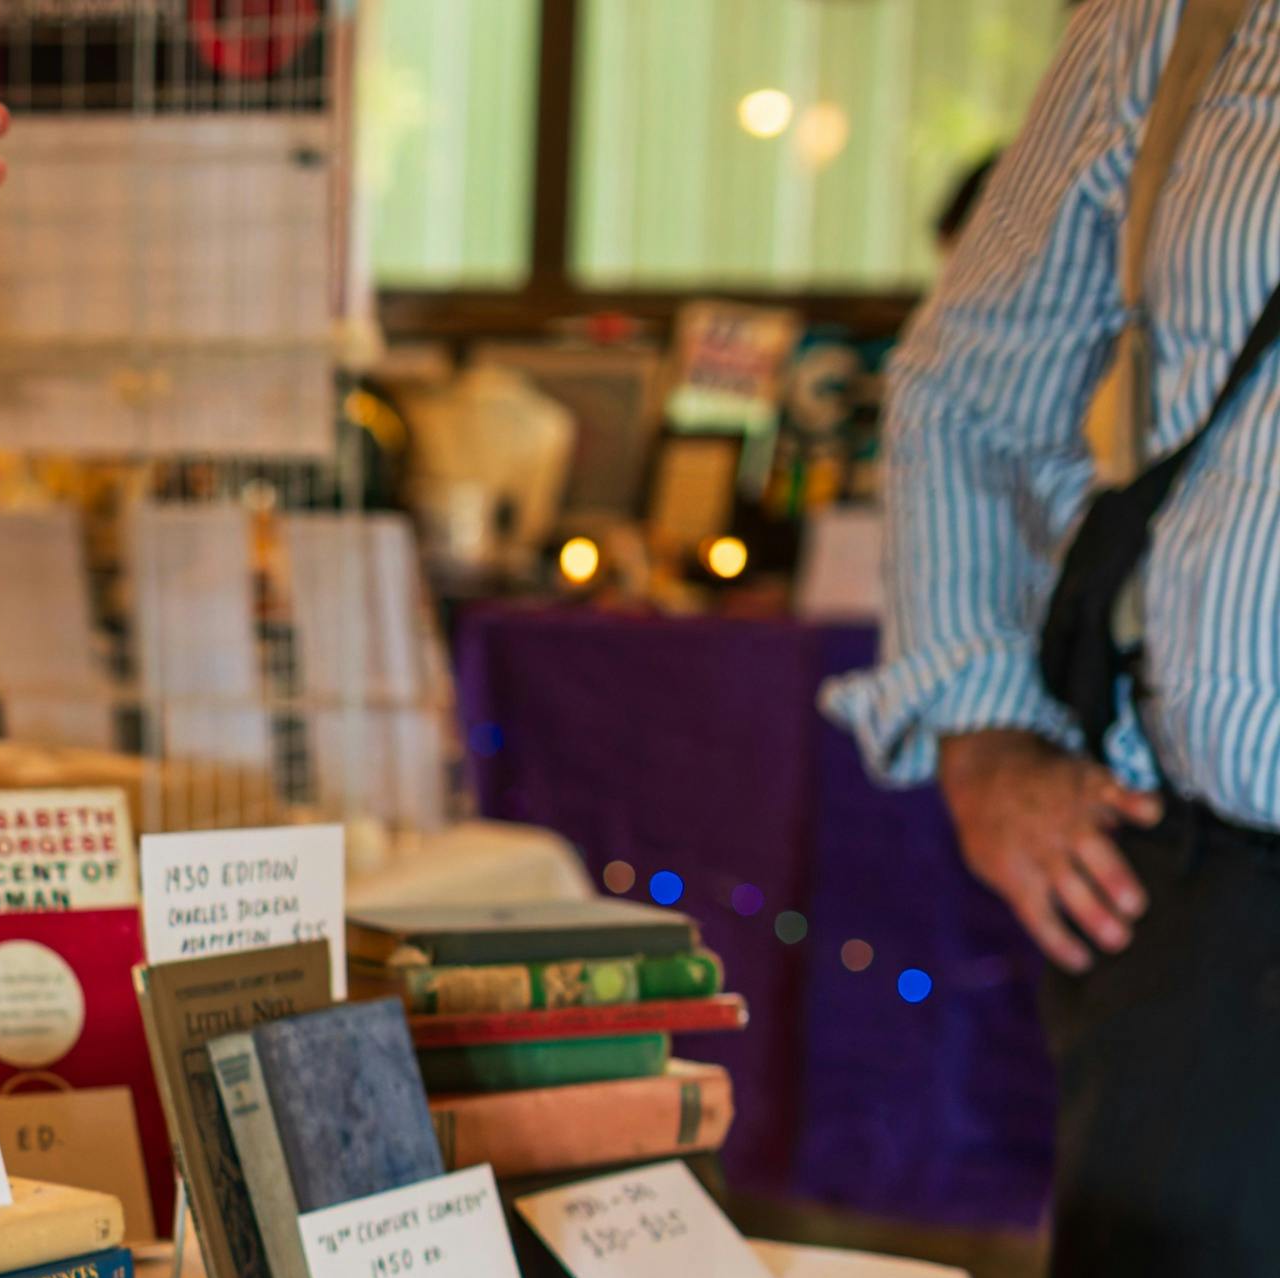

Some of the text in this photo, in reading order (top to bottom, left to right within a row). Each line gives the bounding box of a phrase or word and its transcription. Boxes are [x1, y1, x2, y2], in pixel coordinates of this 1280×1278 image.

[81, 860, 120, 882] OF
[221, 855, 299, 887] EDITION
[168, 896, 300, 928] CHARLES DICKENS
[357, 1212, 421, 1245] CENTURY
